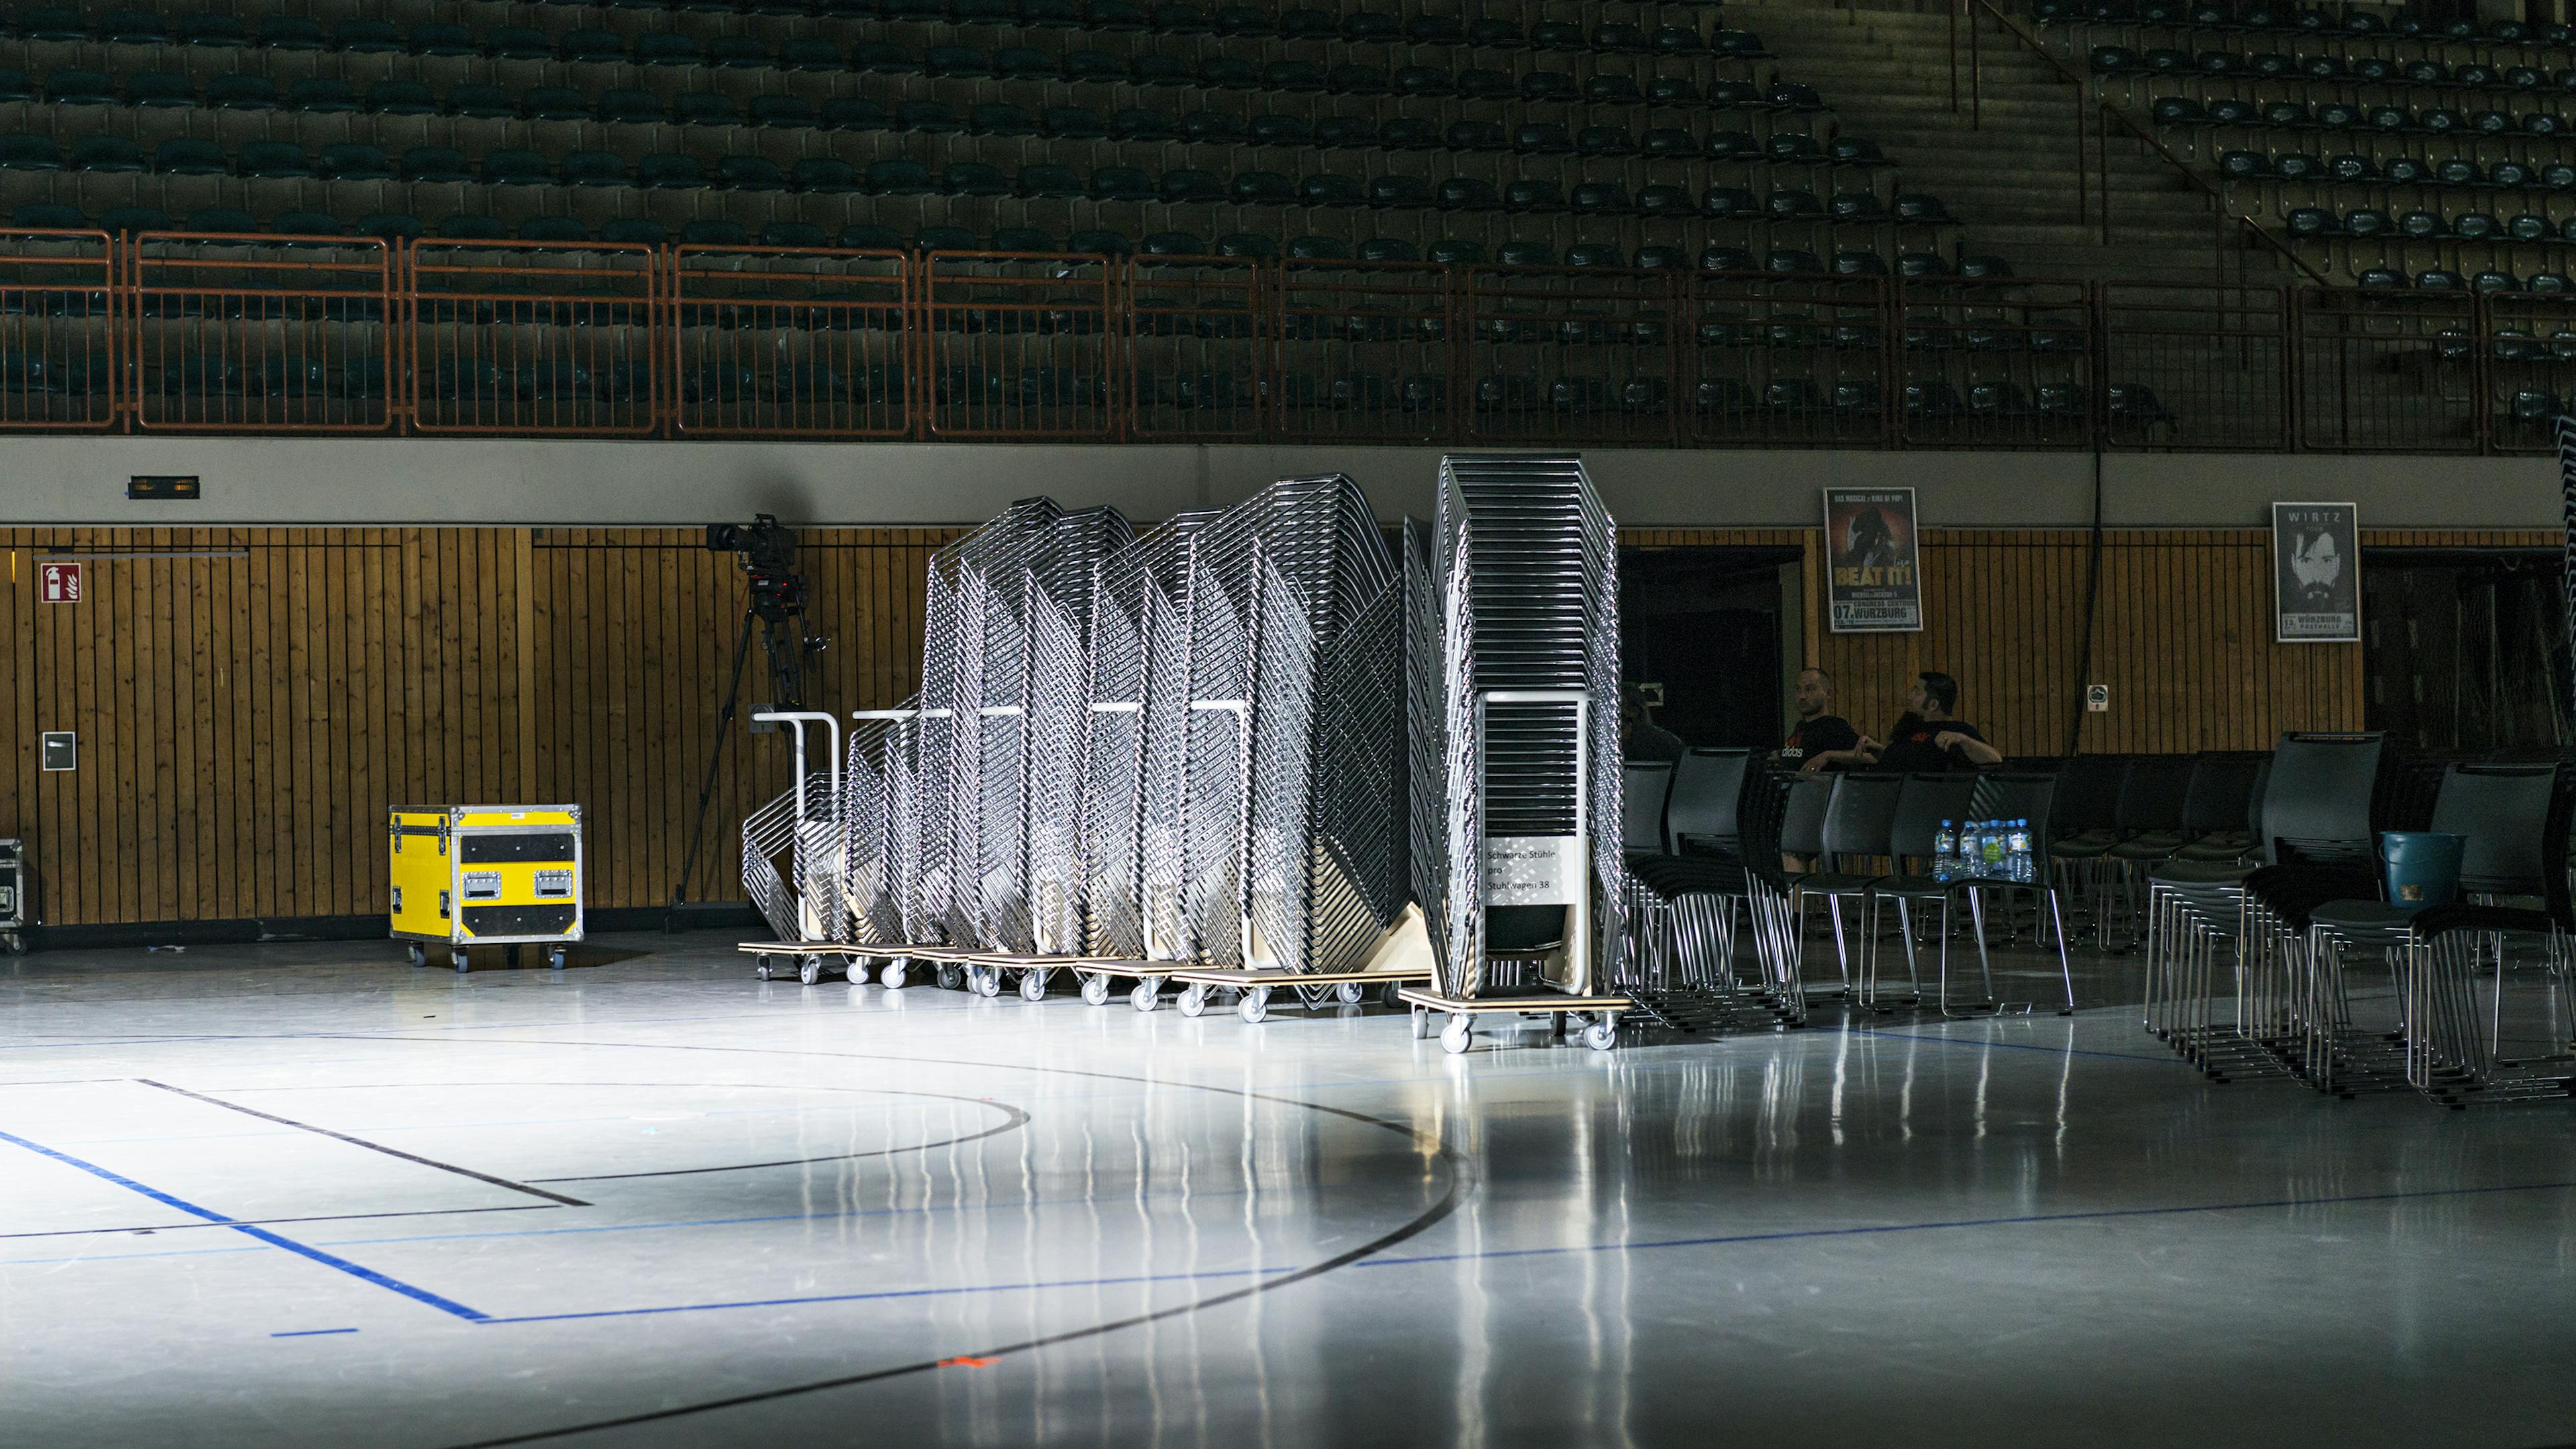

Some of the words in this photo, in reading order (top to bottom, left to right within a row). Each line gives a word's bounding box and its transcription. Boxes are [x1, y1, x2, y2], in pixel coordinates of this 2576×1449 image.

[2288, 512, 2340, 523] WIRTZ
[1835, 566, 1882, 586] BEAT
[1887, 566, 1912, 586] IT!
[1834, 605, 1854, 619] 07.
[1854, 607, 1907, 619] WÜRZBURG
[2298, 614, 2342, 623] WÜRZBURG
[1487, 851, 1527, 859] Schwarze
[1529, 850, 1555, 859] Stühle
[1488, 867, 1502, 875] pro
[1488, 881, 1537, 891] Stuhlwagen
[1539, 881, 1549, 889] 38
